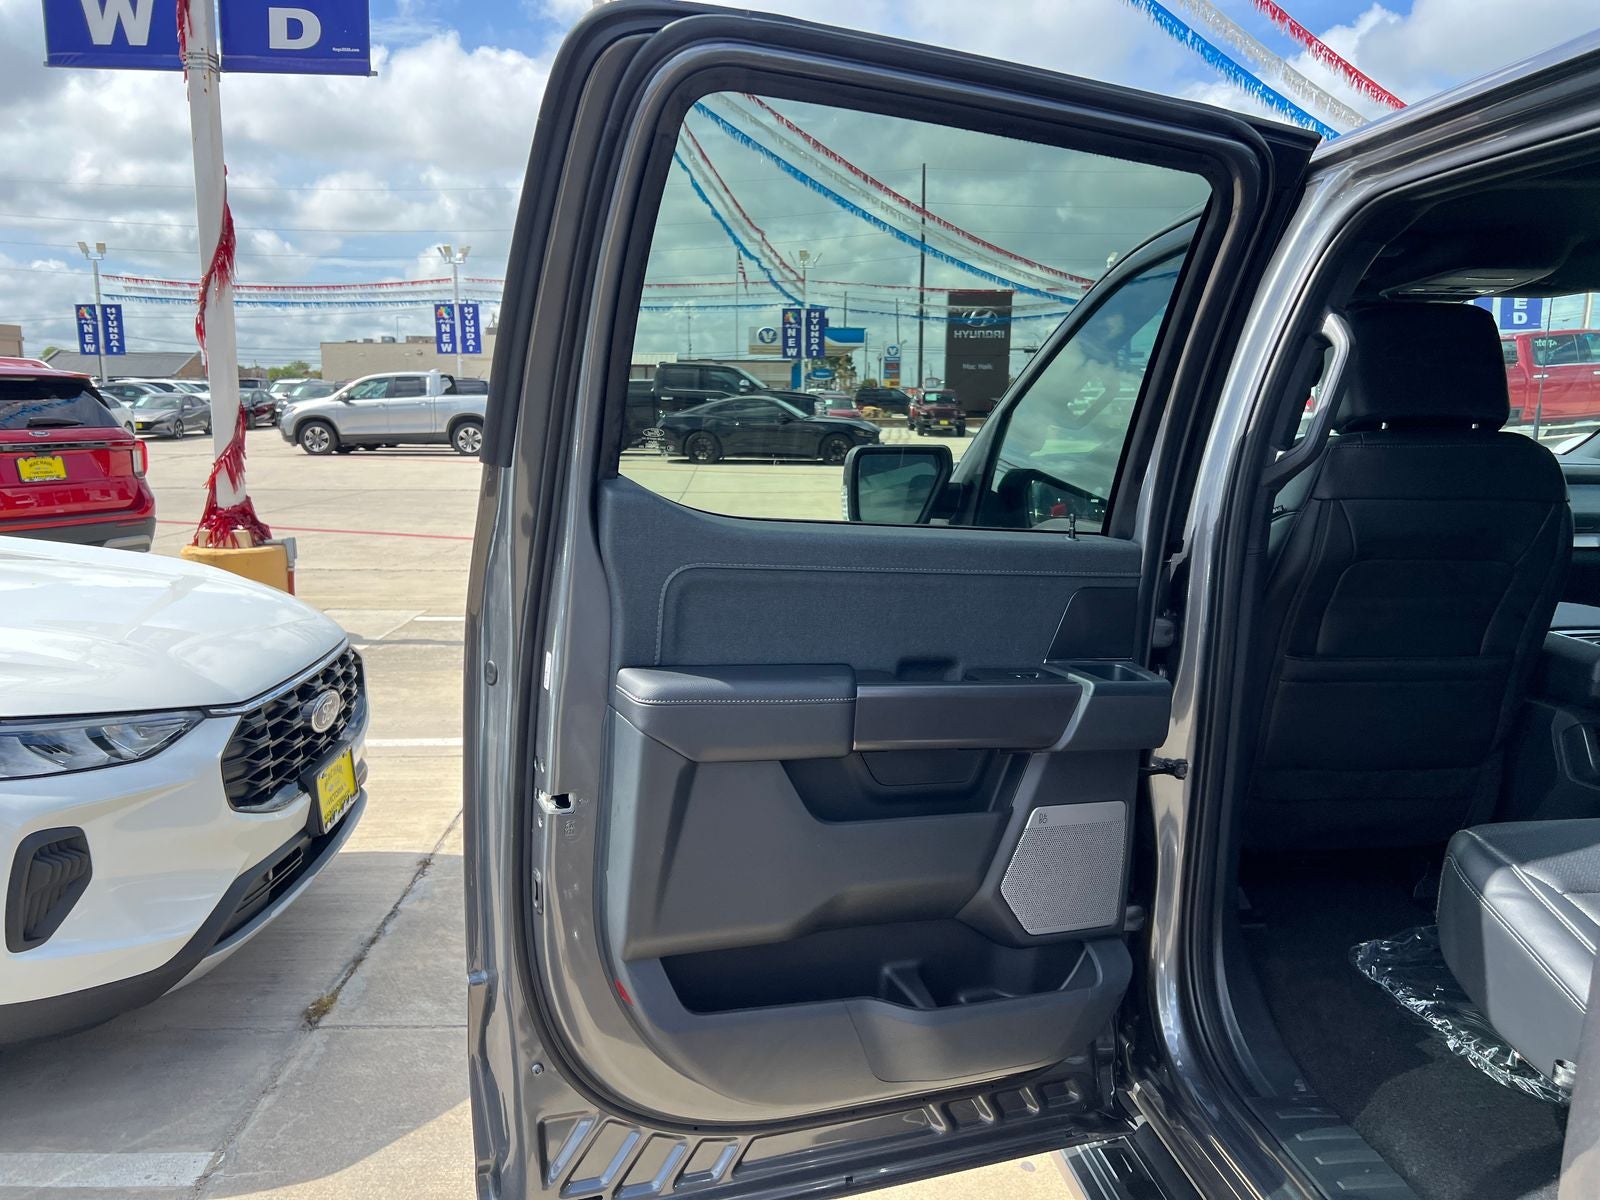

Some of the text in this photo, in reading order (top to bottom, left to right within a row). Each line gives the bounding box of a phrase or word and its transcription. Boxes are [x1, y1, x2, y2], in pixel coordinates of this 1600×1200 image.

[81, 0, 153, 46] W
[268, 7, 322, 50] D
[84, 324, 96, 353] NEW
[107, 308, 119, 353] HYUNDAI
[441, 324, 452, 353] NEW
[464, 307, 476, 352] HYUNDAI
[786, 329, 798, 357] NEW
[810, 312, 820, 356] HYUNDAI
[954, 330, 1005, 339] HYUNDAI
